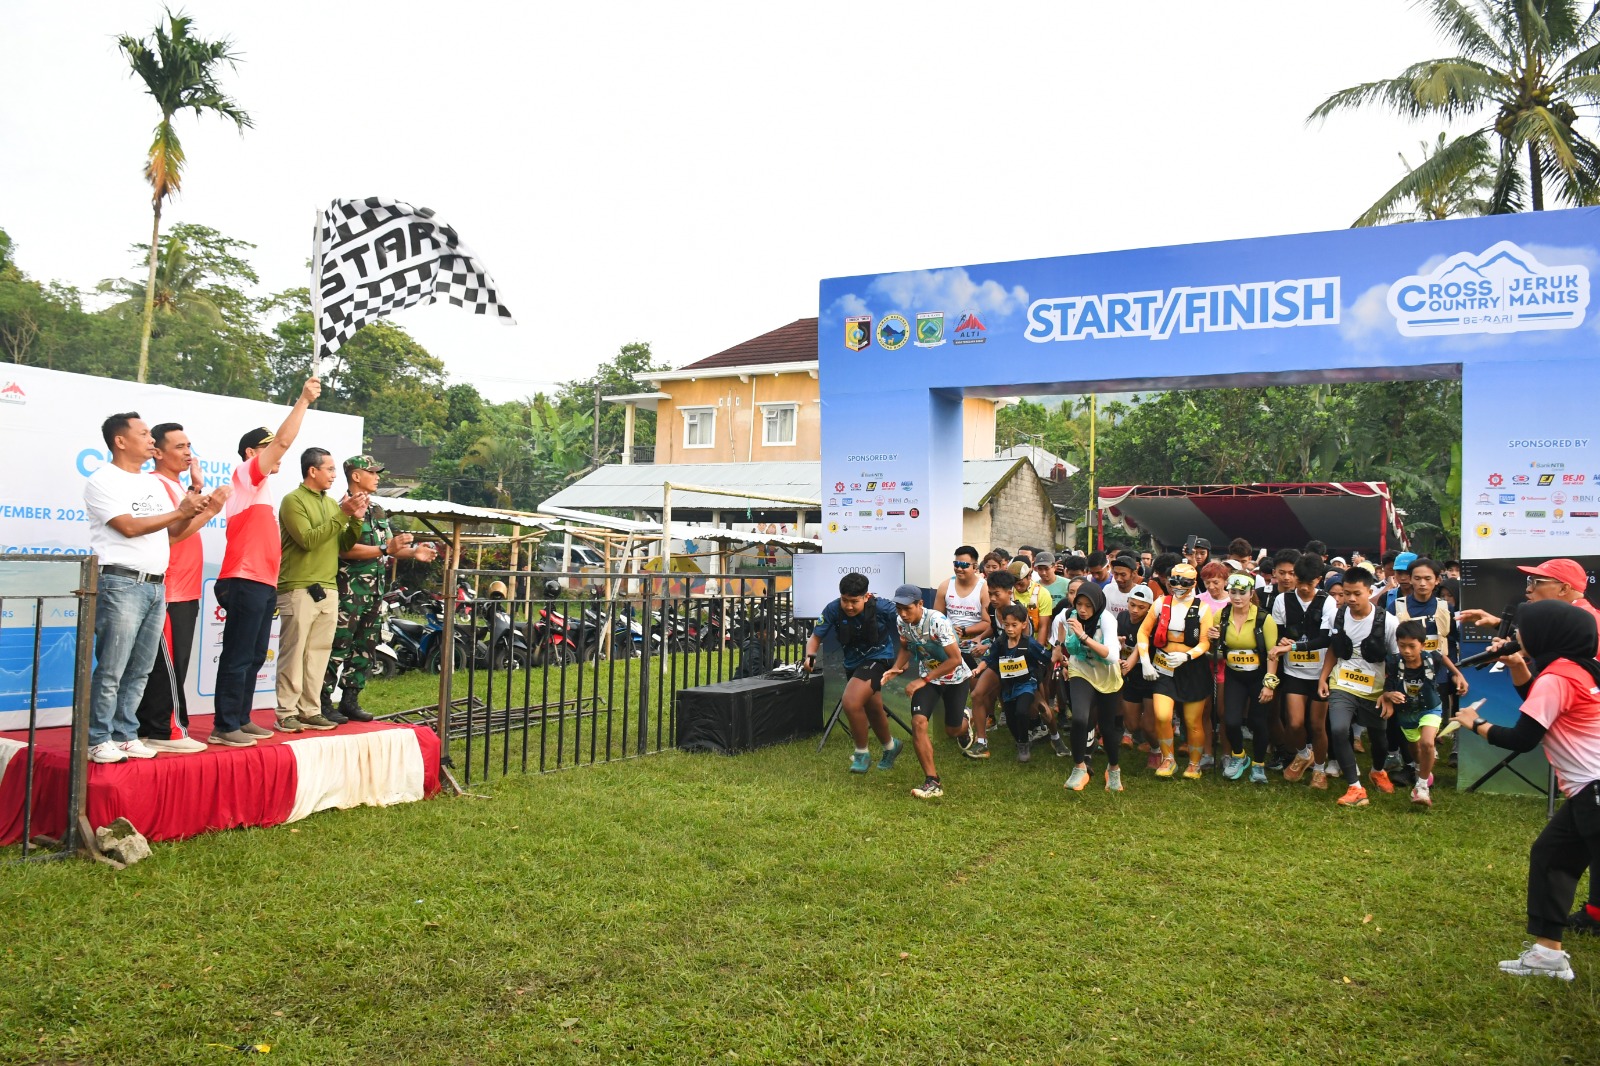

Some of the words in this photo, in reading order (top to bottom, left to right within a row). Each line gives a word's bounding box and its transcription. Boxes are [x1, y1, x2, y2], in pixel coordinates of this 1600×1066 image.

[1509, 275, 1579, 292] JERUK
[1510, 290, 1579, 307] MANIS
[1027, 280, 1337, 340] START/FINISH
[1509, 440, 1572, 448] SPONSORED
[1575, 439, 1588, 447] BY
[848, 454, 887, 462] SPONSORED
[1562, 474, 1585, 482] BEJO
[0, 505, 52, 520] EMBER
[1344, 671, 1369, 683] 10205
